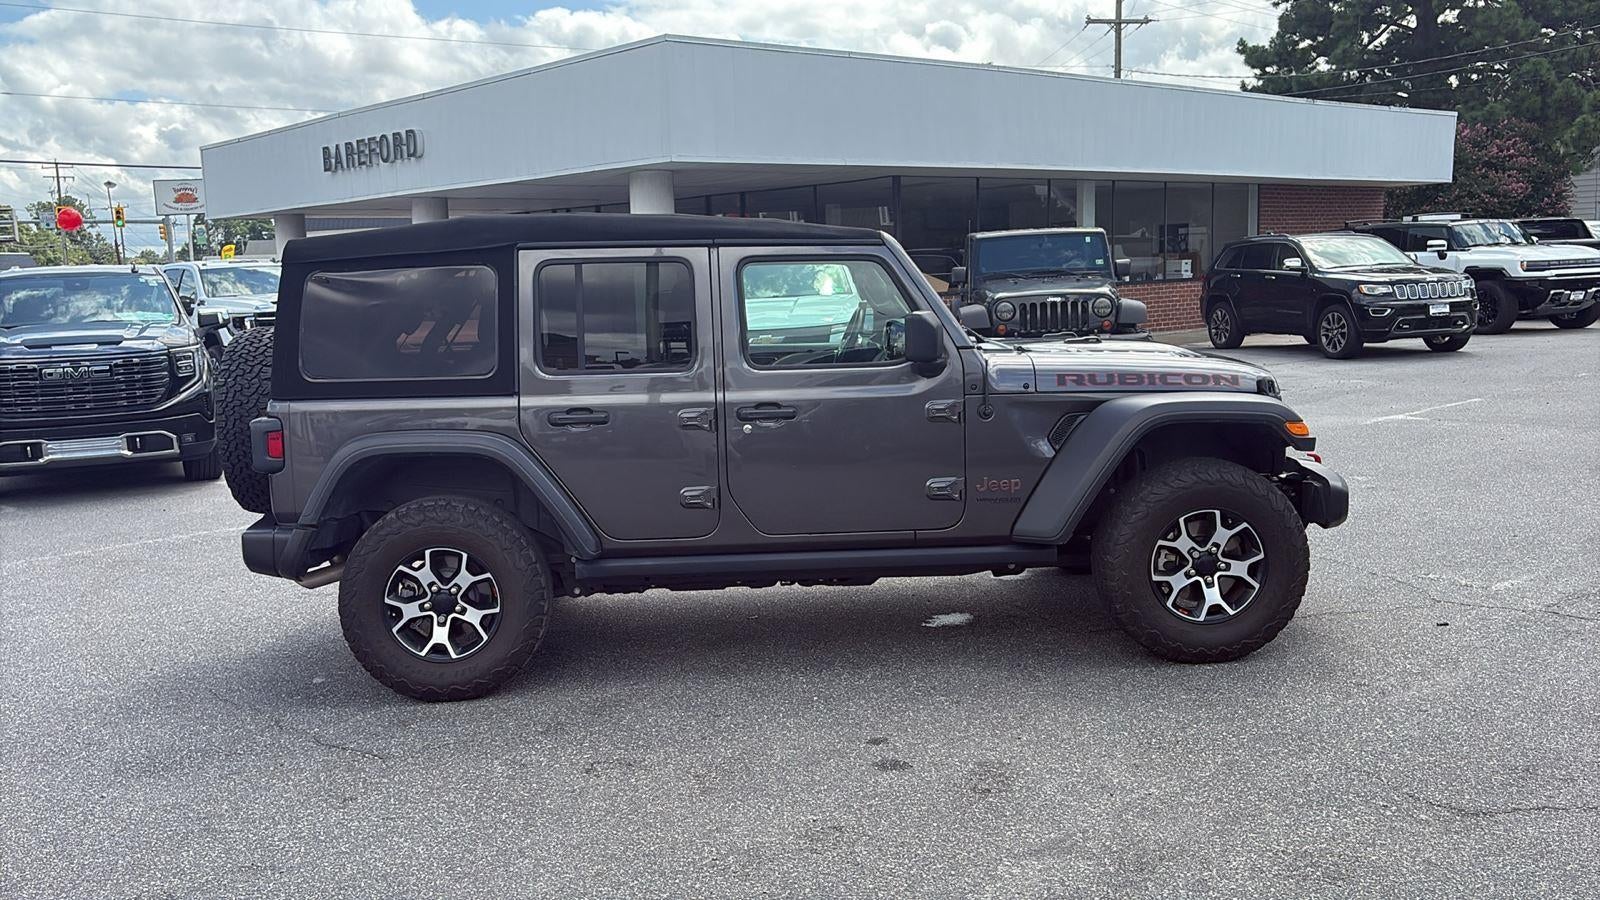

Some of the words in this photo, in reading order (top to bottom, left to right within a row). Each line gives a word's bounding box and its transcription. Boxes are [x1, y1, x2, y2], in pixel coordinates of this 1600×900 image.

[322, 129, 422, 172] BAREFORD
[1046, 295, 1062, 303] Jeep
[41, 365, 111, 380] GMC
[1056, 372, 1240, 388] RUBICON
[976, 476, 1021, 493] Jeep
